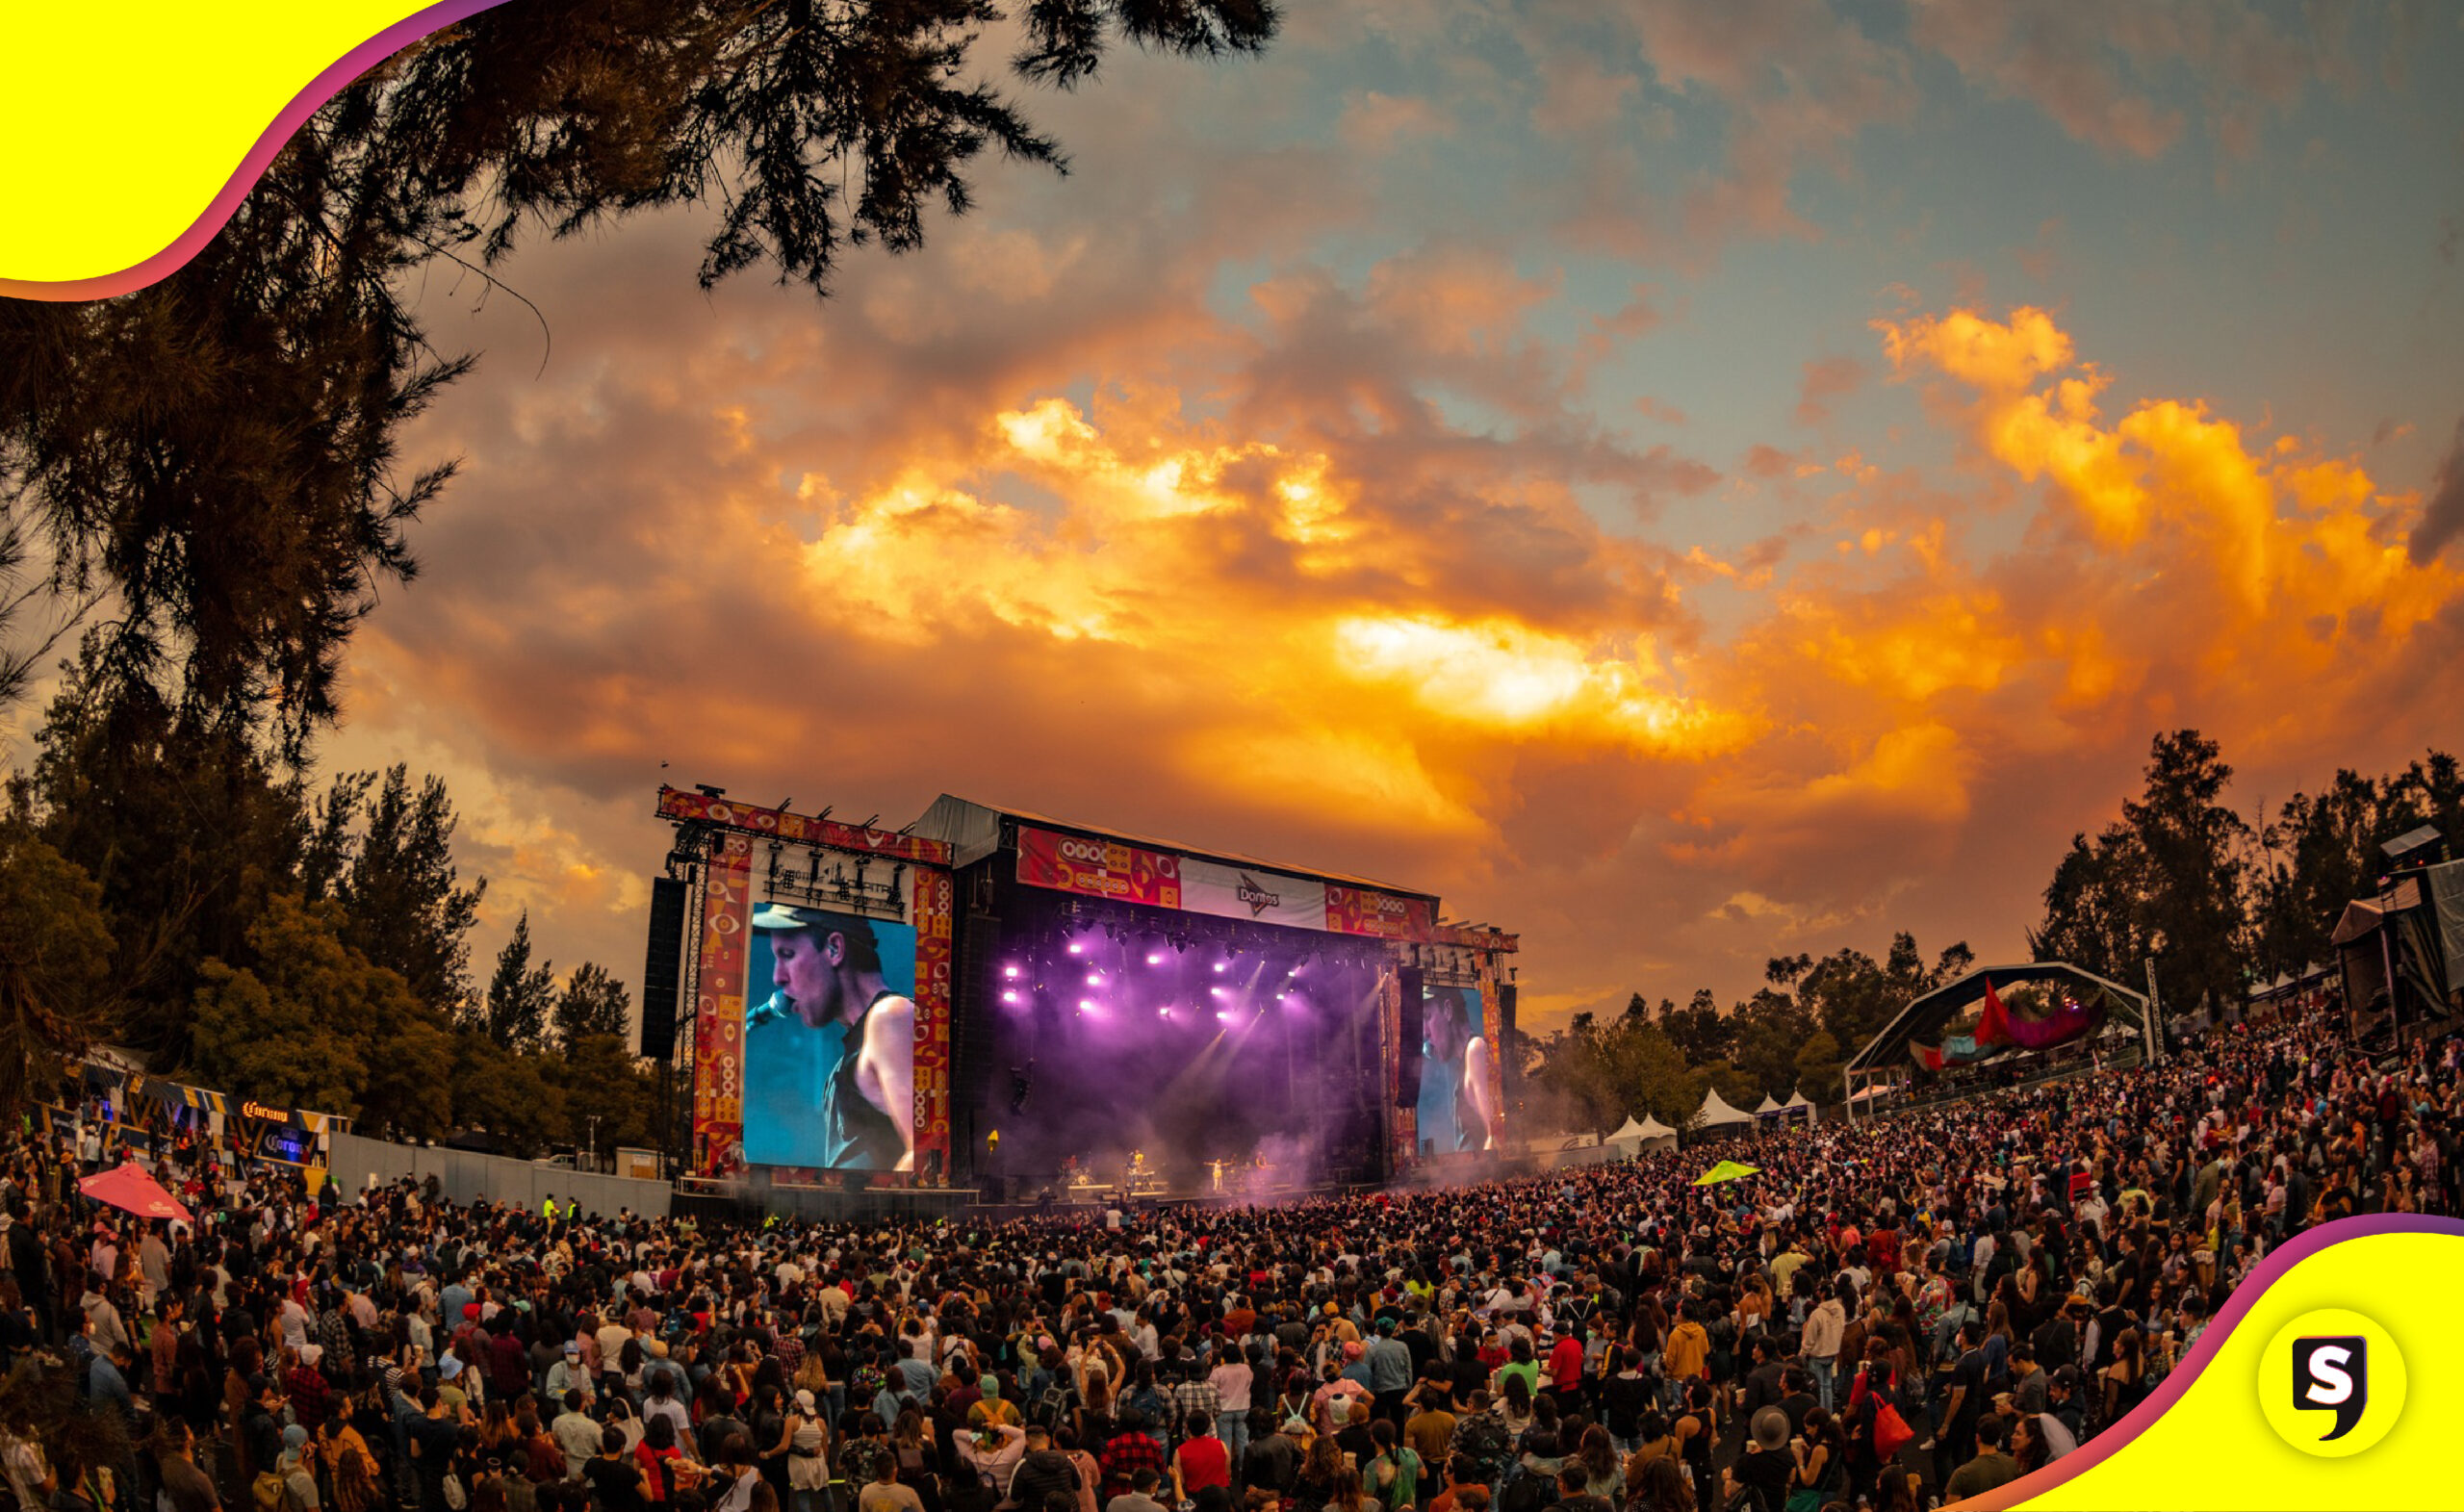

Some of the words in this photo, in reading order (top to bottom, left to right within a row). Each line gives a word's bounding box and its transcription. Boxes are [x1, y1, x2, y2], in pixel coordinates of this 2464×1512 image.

[1240, 886, 1278, 905] Doritos
[243, 1101, 288, 1122] Corona
[265, 1134, 304, 1155] Coron
